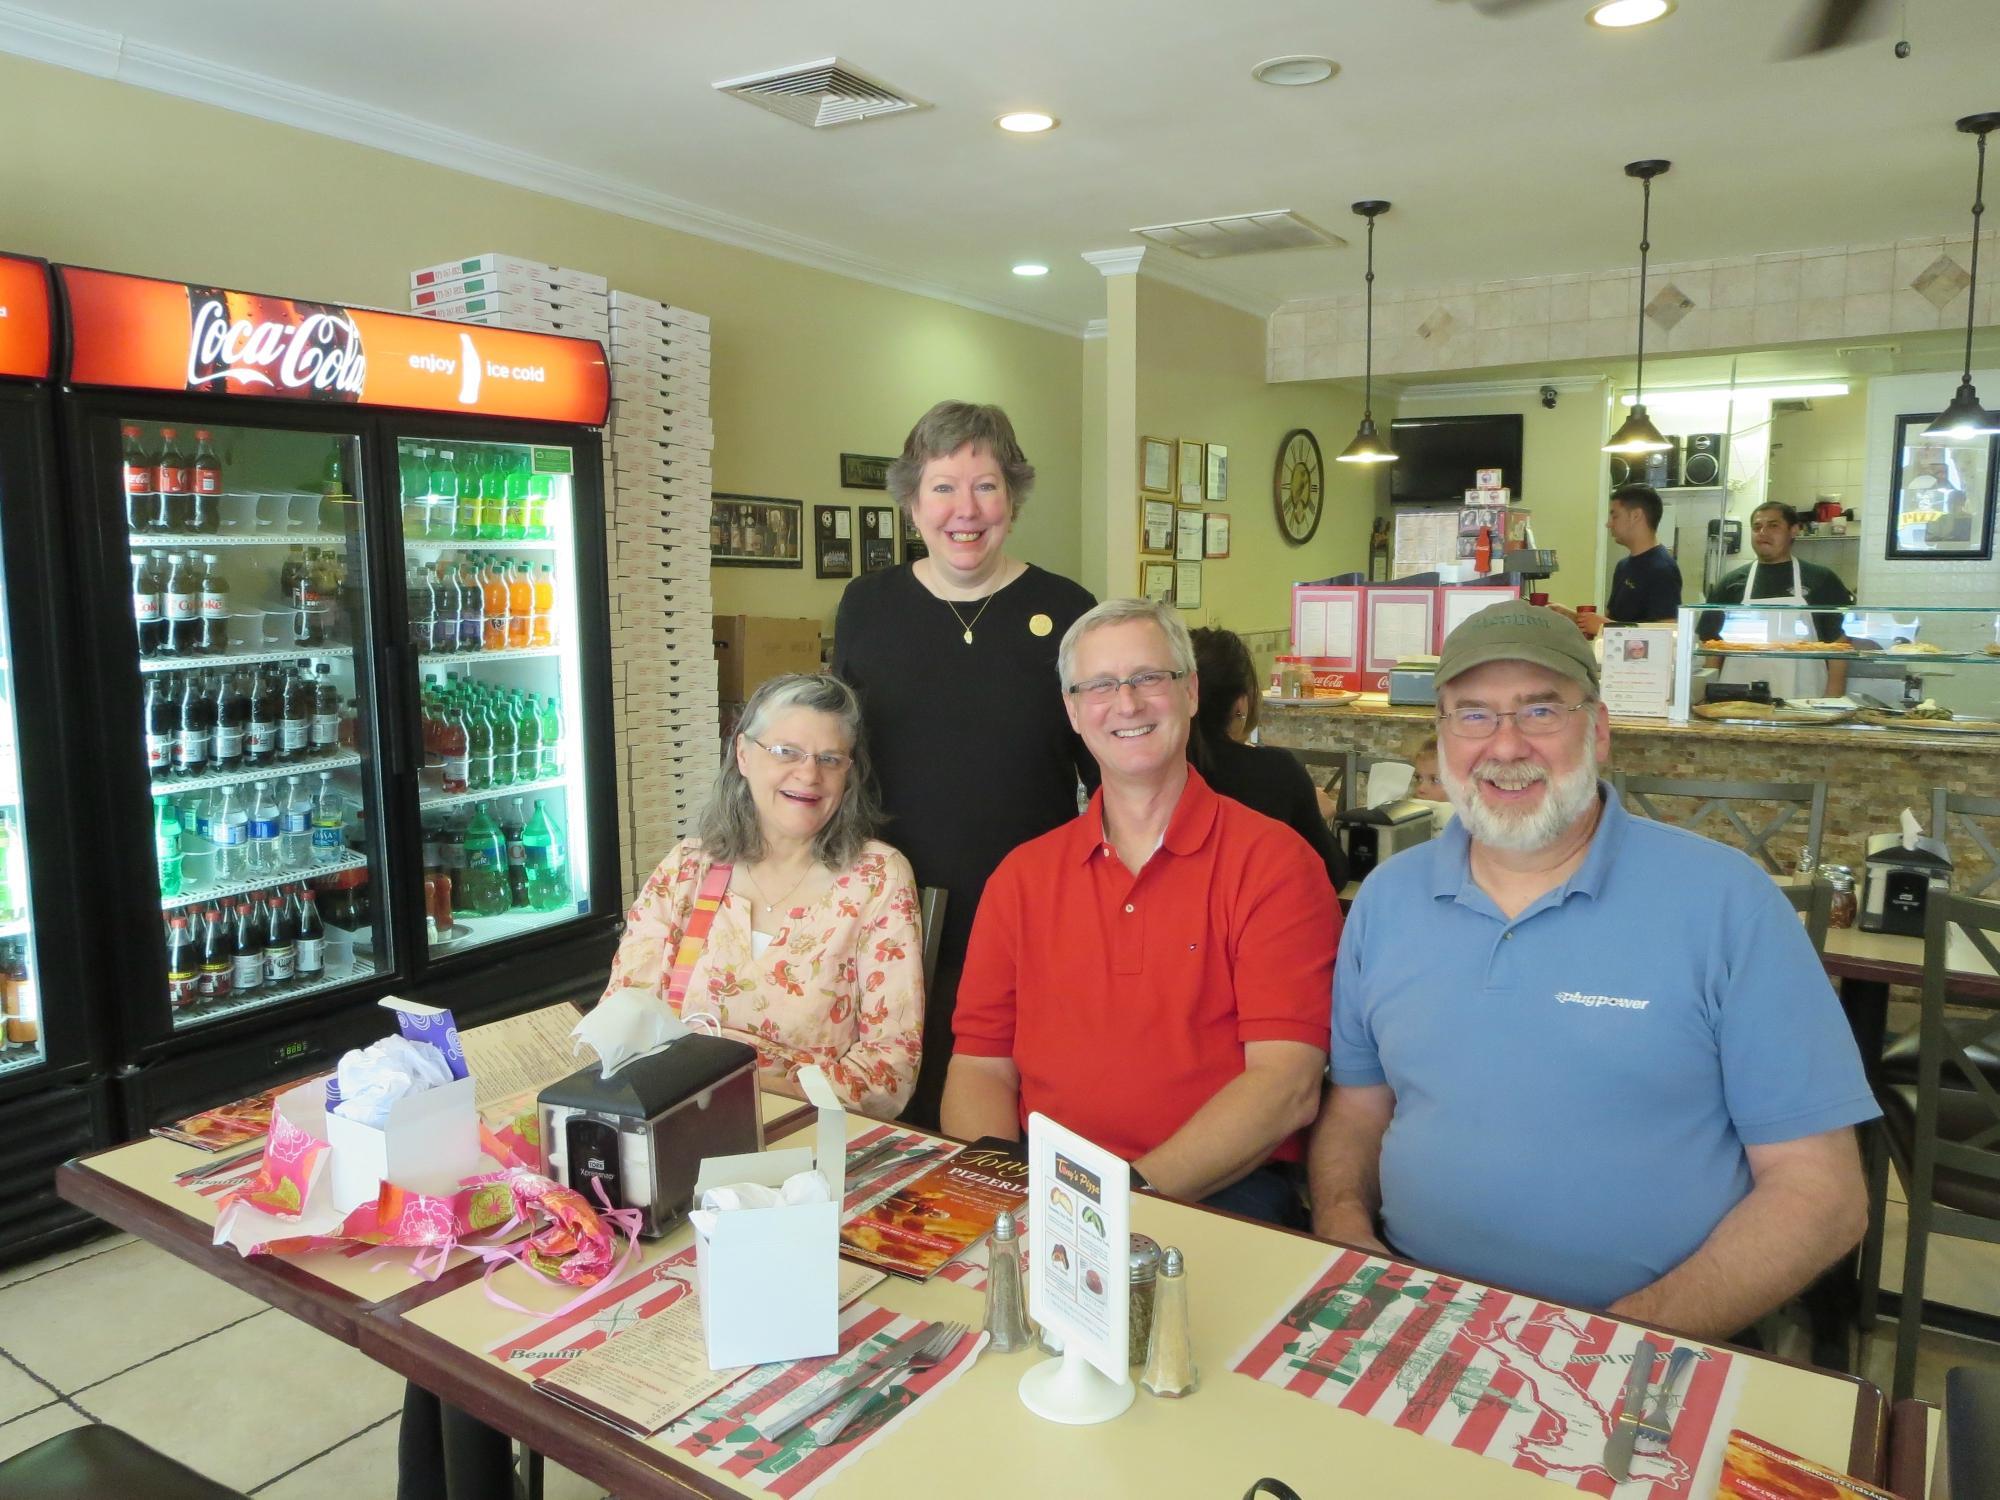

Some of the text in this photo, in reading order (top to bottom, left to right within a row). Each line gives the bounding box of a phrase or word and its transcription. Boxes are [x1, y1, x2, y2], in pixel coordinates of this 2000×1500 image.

[188, 300, 367, 393] Coca-Cola
[409, 352, 545, 382] enjoy ice cold
[588, 1160, 604, 1170] TORK
[947, 1167, 1029, 1195] PIZZERIA
[1569, 1353, 1616, 1366] Italy
